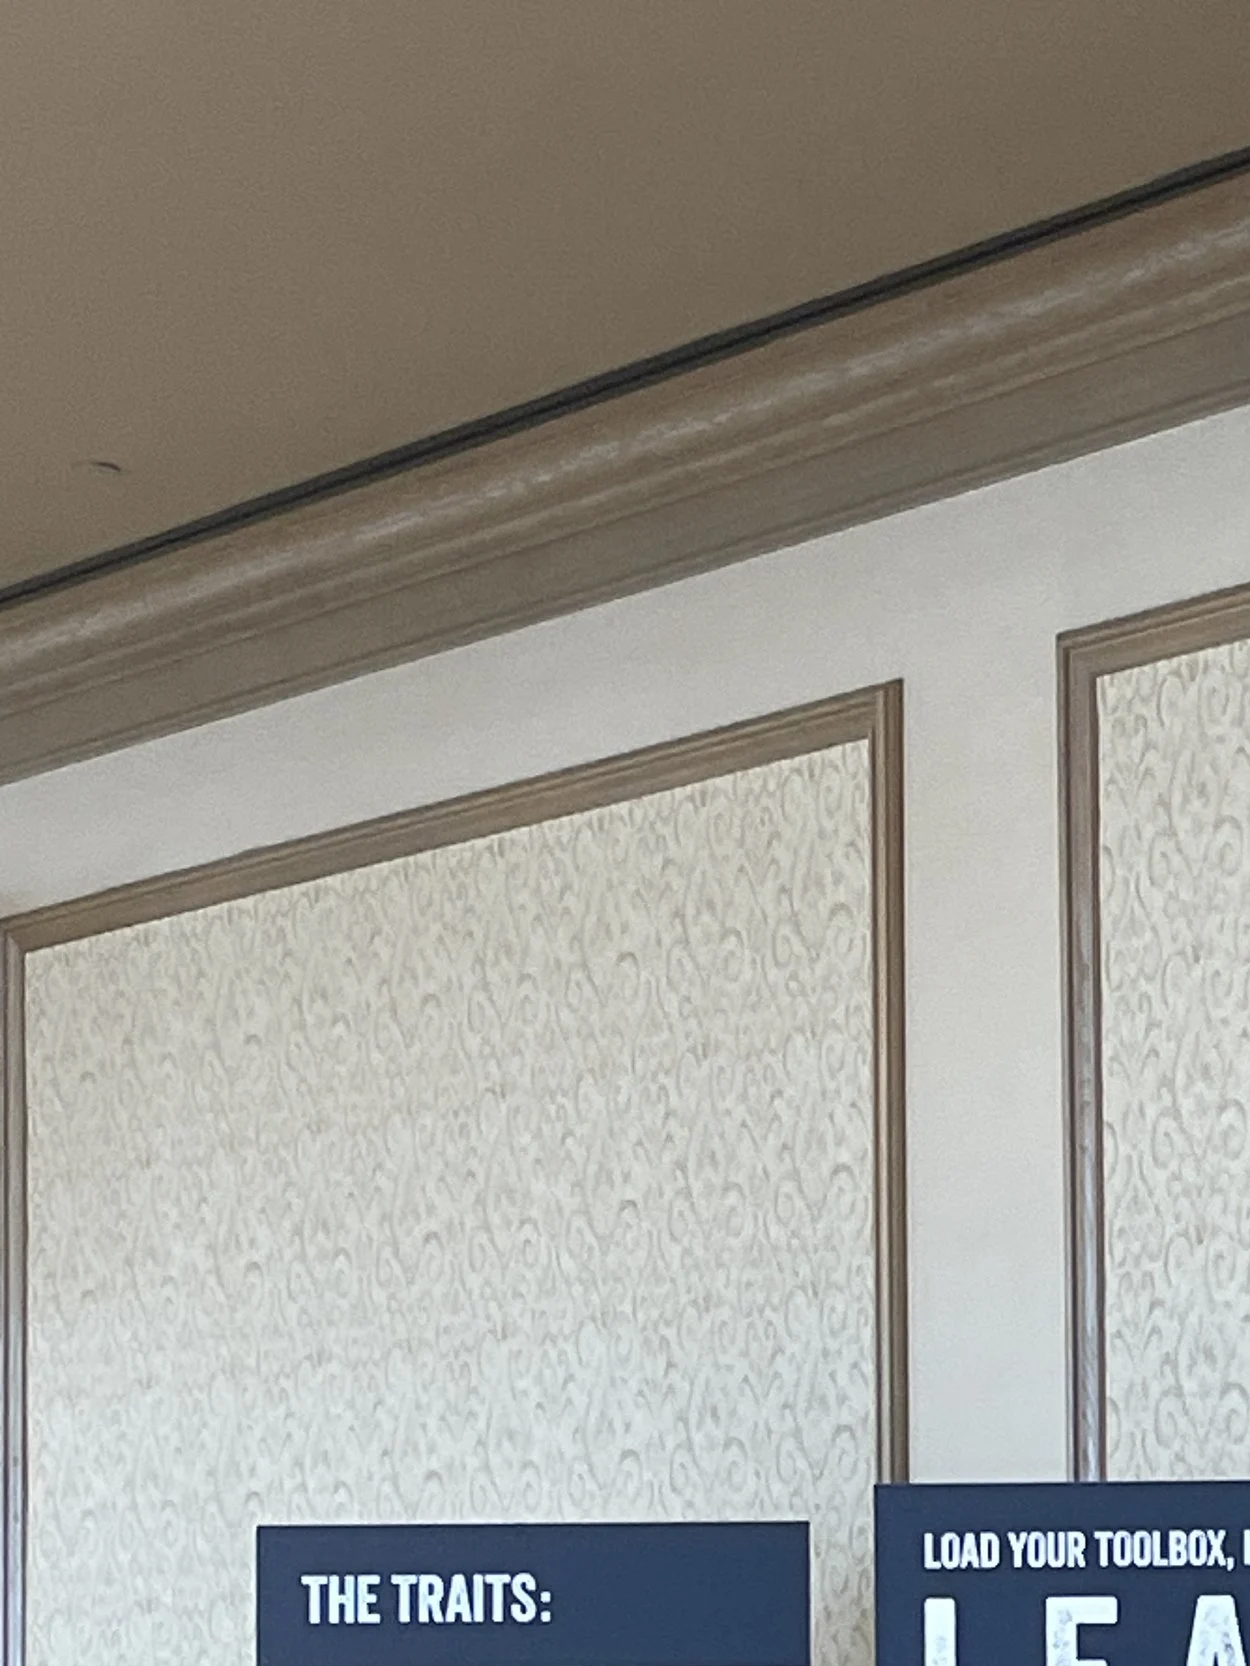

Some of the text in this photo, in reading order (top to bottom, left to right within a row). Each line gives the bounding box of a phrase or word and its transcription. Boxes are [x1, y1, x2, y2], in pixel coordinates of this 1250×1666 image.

[924, 1532, 1000, 1570] LOAD
[1008, 1531, 1086, 1568] YOUR
[1095, 1530, 1234, 1571] TOOLBOX,
[301, 1573, 552, 1624] THE TRAITS:
